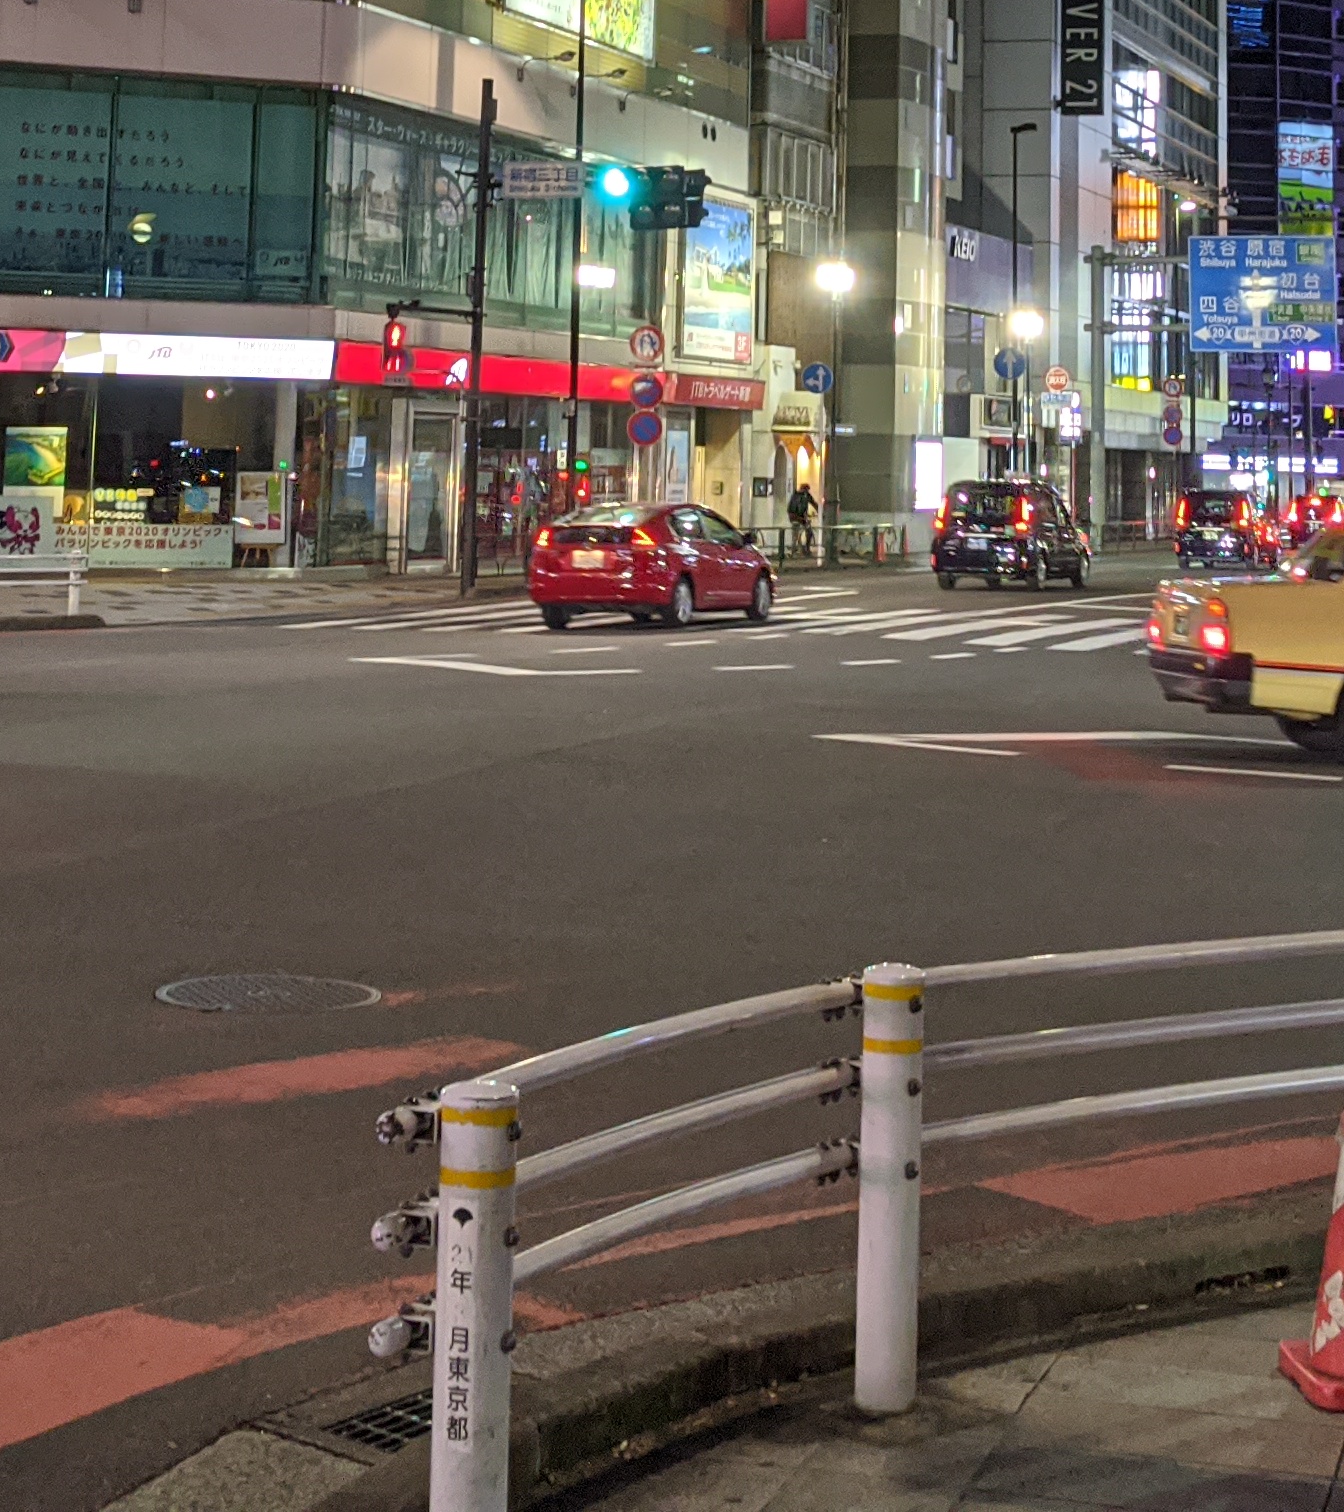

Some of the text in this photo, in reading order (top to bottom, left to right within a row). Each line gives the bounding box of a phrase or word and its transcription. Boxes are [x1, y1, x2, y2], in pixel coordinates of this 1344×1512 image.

[1065, 80, 1099, 108] 21
[510, 167, 578, 182] 新宿三丁目
[953, 235, 976, 262] KEIO
[1198, 239, 1237, 257] 渋谷
[1247, 239, 1286, 257] 原宿
[1200, 257, 1237, 269] Shibuya
[1245, 257, 1287, 269] Harajuku
[1280, 272, 1320, 290] 初台
[1280, 290, 1321, 299] Hatsudai
[1199, 296, 1241, 313] 四谷
[1202, 314, 1239, 325] Yotsuya
[1212, 328, 1225, 339] 20
[1290, 328, 1302, 339] 20
[737, 335, 747, 352] 3F
[147, 346, 173, 360] JTB
[1231, 411, 1303, 428] リロープ
